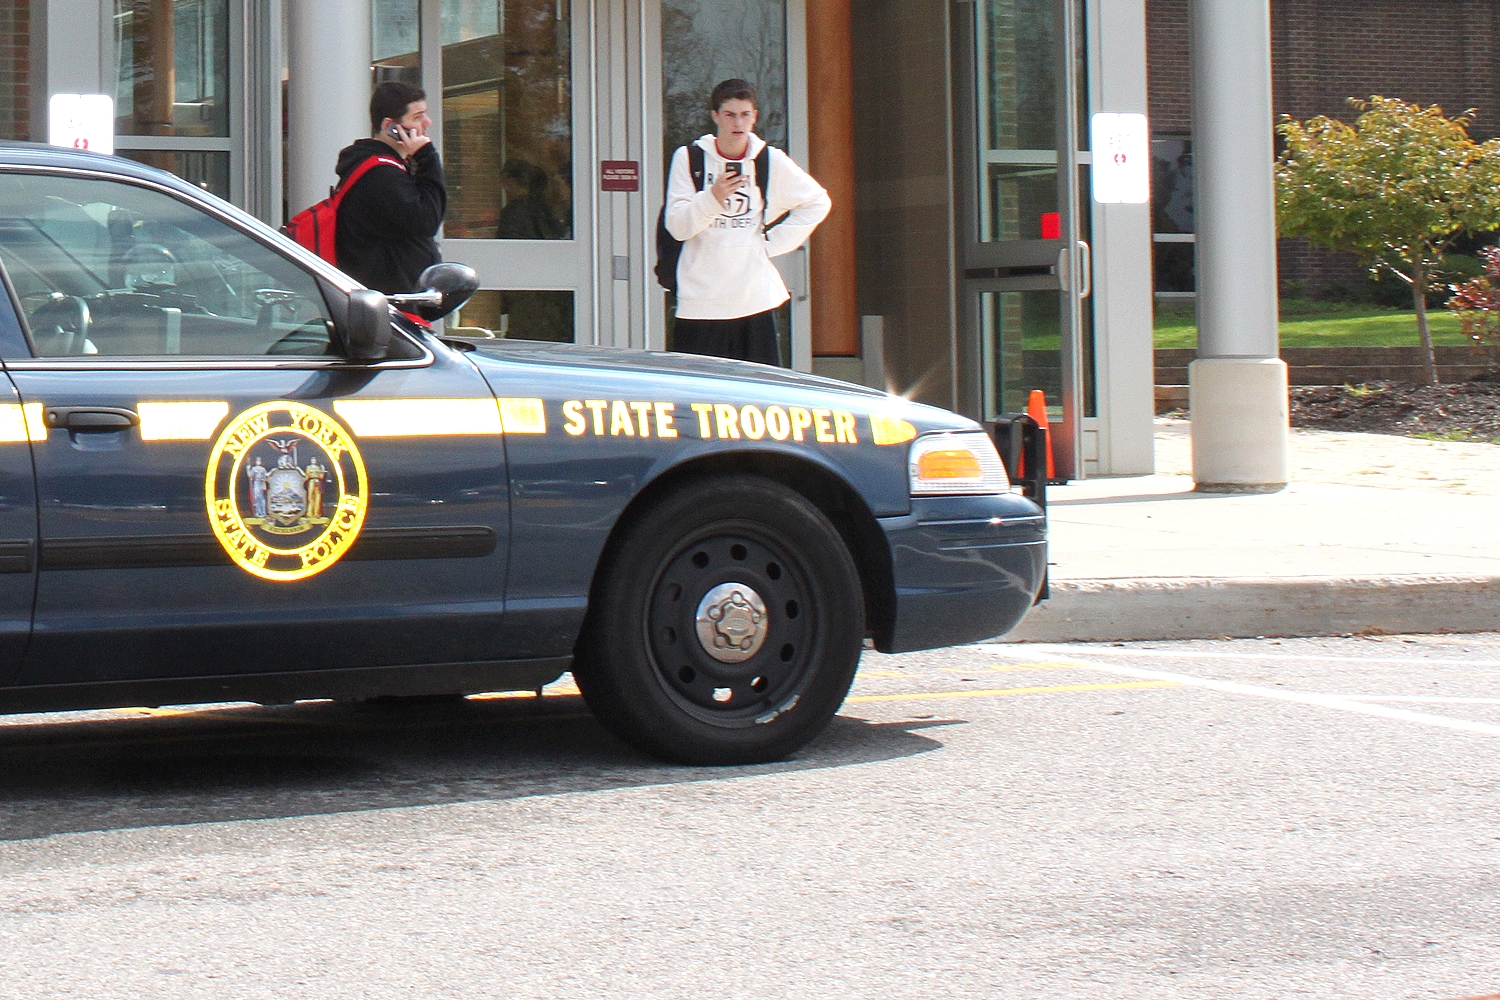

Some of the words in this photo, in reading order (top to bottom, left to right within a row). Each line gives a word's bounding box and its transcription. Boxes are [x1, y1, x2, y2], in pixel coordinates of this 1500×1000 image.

[223, 411, 270, 460] NEW
[288, 410, 349, 461] YORK
[562, 399, 678, 438] STATE
[691, 402, 858, 444] TROOPER
[214, 498, 270, 569] STATE
[298, 494, 360, 569] POLICE
